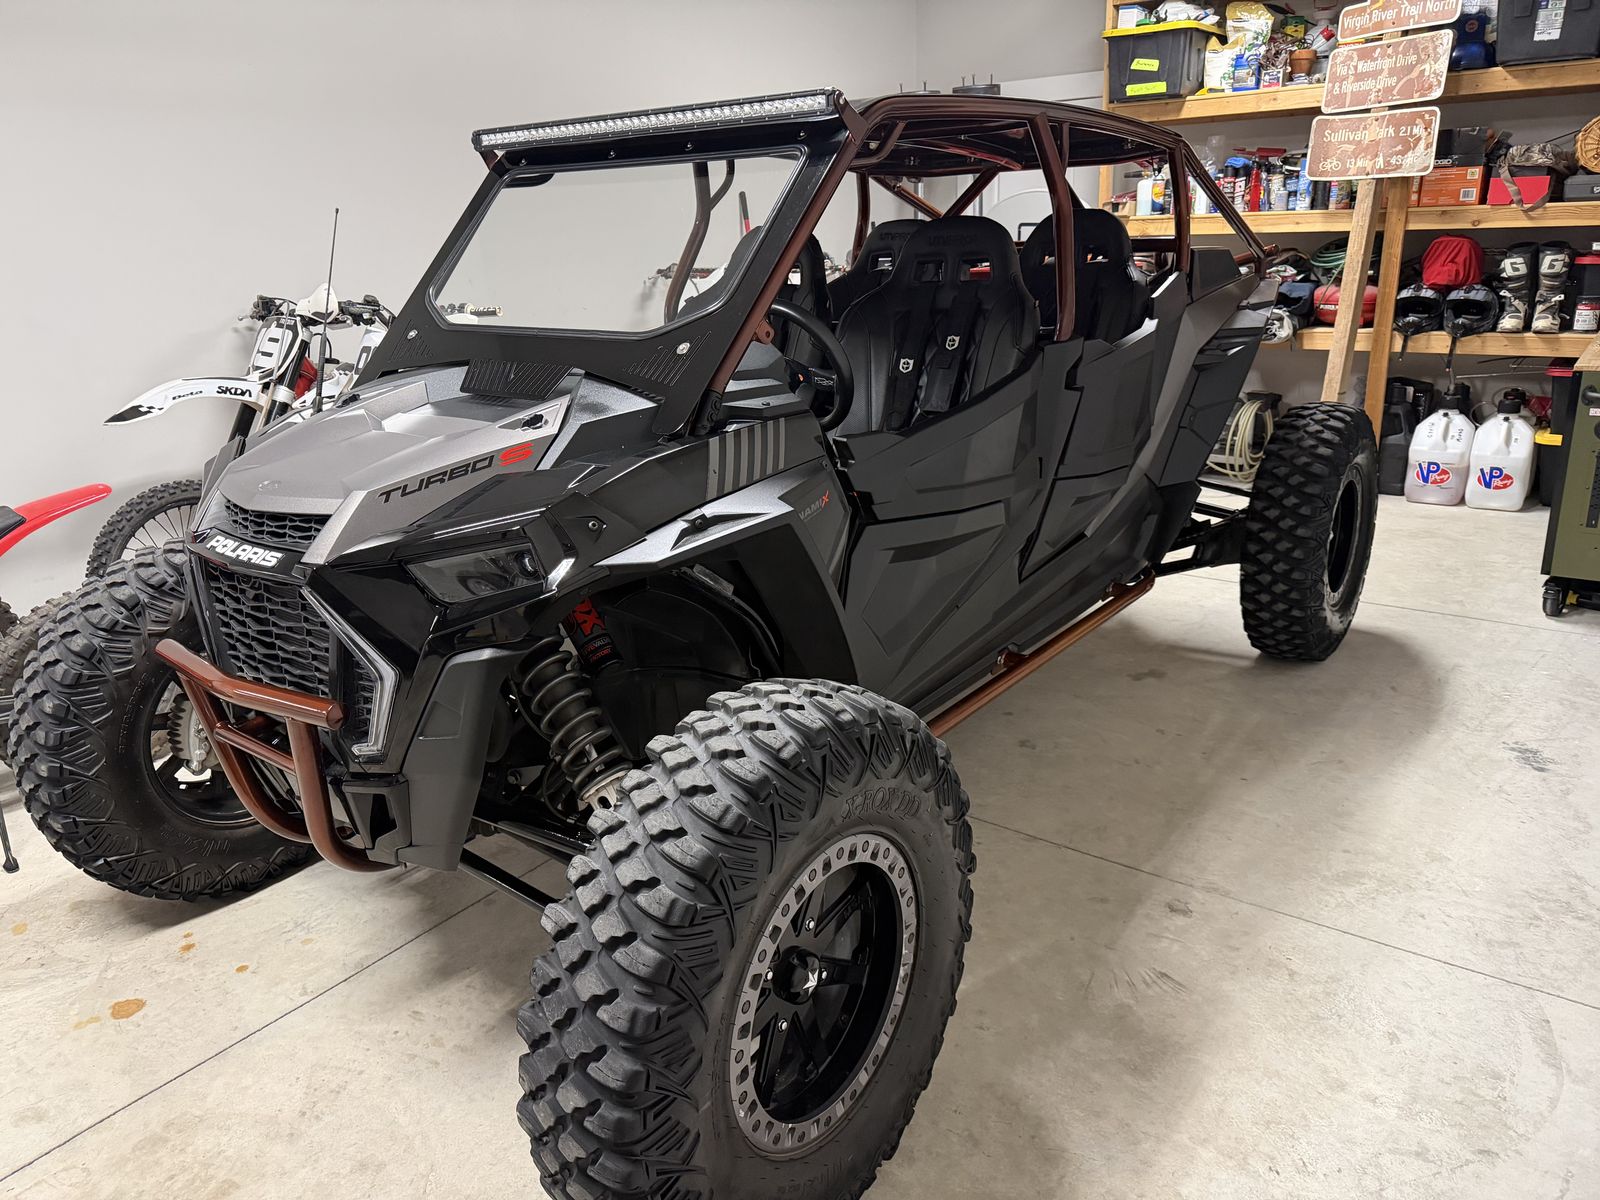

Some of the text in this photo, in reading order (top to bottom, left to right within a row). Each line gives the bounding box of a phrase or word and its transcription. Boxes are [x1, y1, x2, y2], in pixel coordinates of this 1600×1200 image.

[1343, 14, 1370, 31] Virgin
[1371, 8, 1397, 23] River
[1400, 2, 1424, 17] Trail
[1425, 0, 1456, 13] North
[1336, 63, 1347, 76] Via
[1357, 56, 1396, 73] Waterfront
[1396, 54, 1417, 67] Drive
[1333, 75, 1397, 95] & Riverside Drive
[1323, 129, 1368, 142] Sullivan
[216, 385, 252, 398] SKDA
[378, 442, 534, 504] TURBO S
[1418, 461, 1441, 484] VP
[1480, 466, 1504, 489] VP
[206, 535, 284, 567] POLARIS
